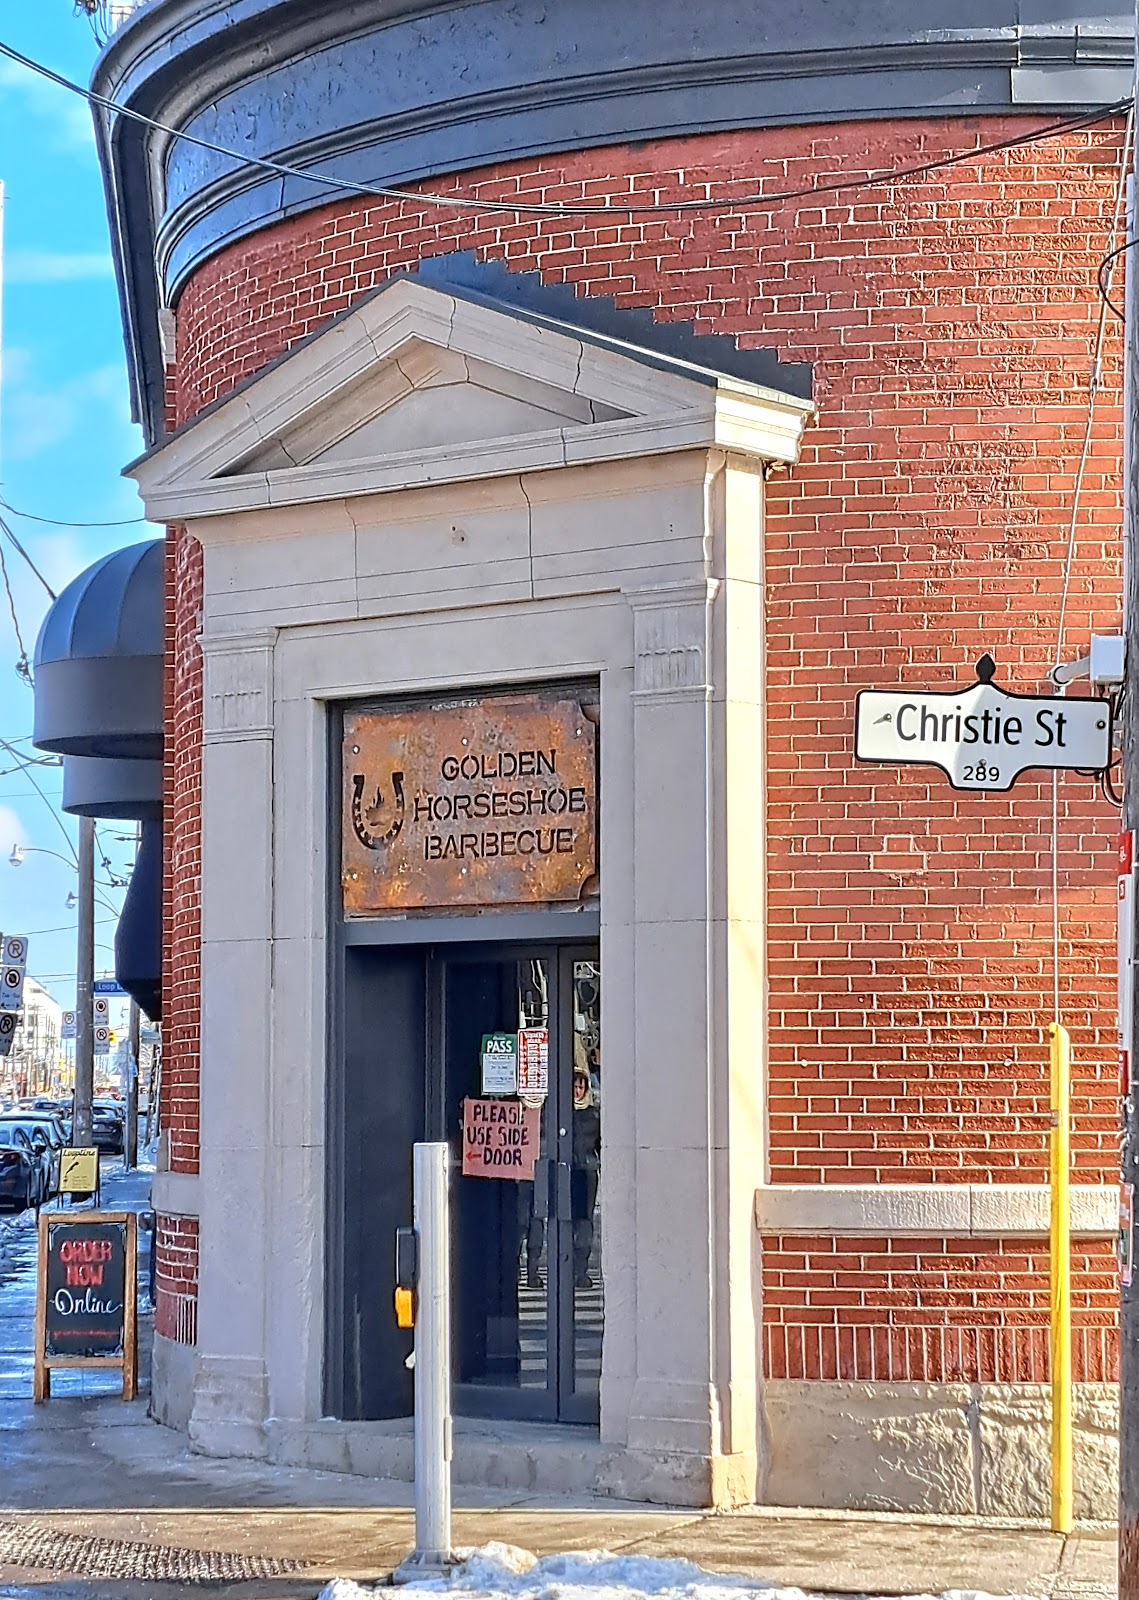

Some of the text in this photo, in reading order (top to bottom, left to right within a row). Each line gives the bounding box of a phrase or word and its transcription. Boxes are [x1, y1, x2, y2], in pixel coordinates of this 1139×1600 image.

[896, 703, 1067, 748] Christie St
[441, 748, 557, 781] GOLDEN
[962, 765, 1000, 782] 289
[413, 787, 586, 823] HORSESHOE
[424, 828, 574, 861] BARBECUE
[486, 1040, 512, 1053] PASS
[466, 1126, 530, 1147] USE SIDE
[483, 1147, 523, 1166] DOOR
[60, 1240, 112, 1262] ORDER
[66, 1264, 104, 1286] NOW
[53, 1287, 123, 1315] Online
